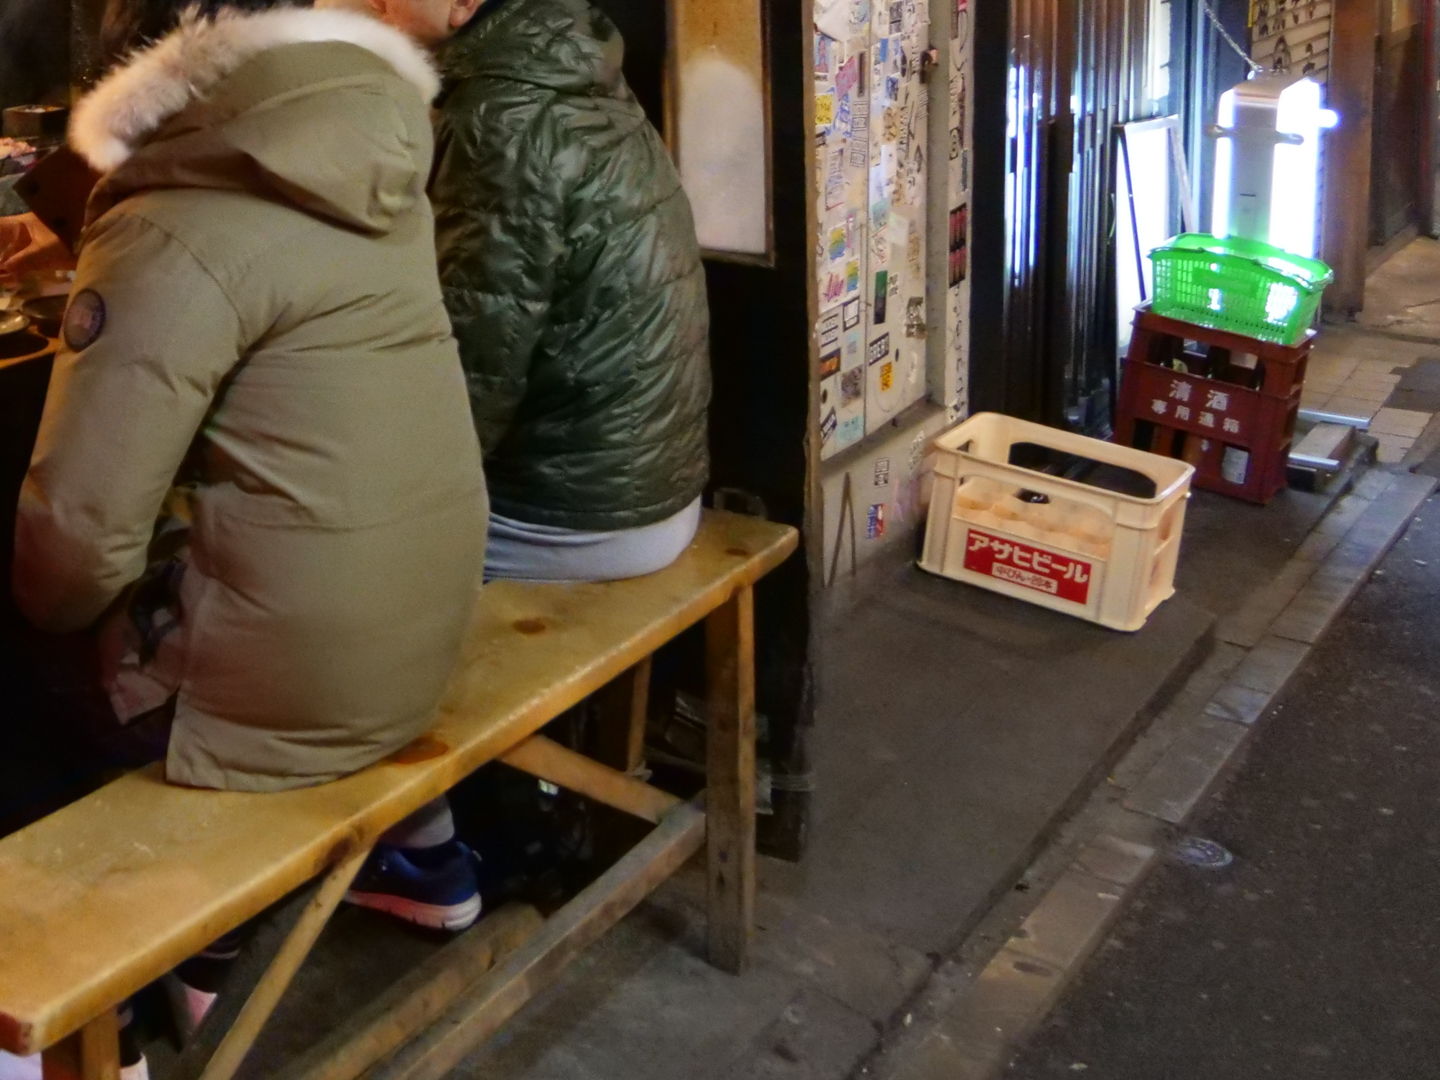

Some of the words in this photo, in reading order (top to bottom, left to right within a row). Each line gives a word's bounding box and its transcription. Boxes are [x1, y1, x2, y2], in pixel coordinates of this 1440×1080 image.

[1169, 379, 1230, 411] 清酒
[967, 532, 1089, 583] アサヒビール
